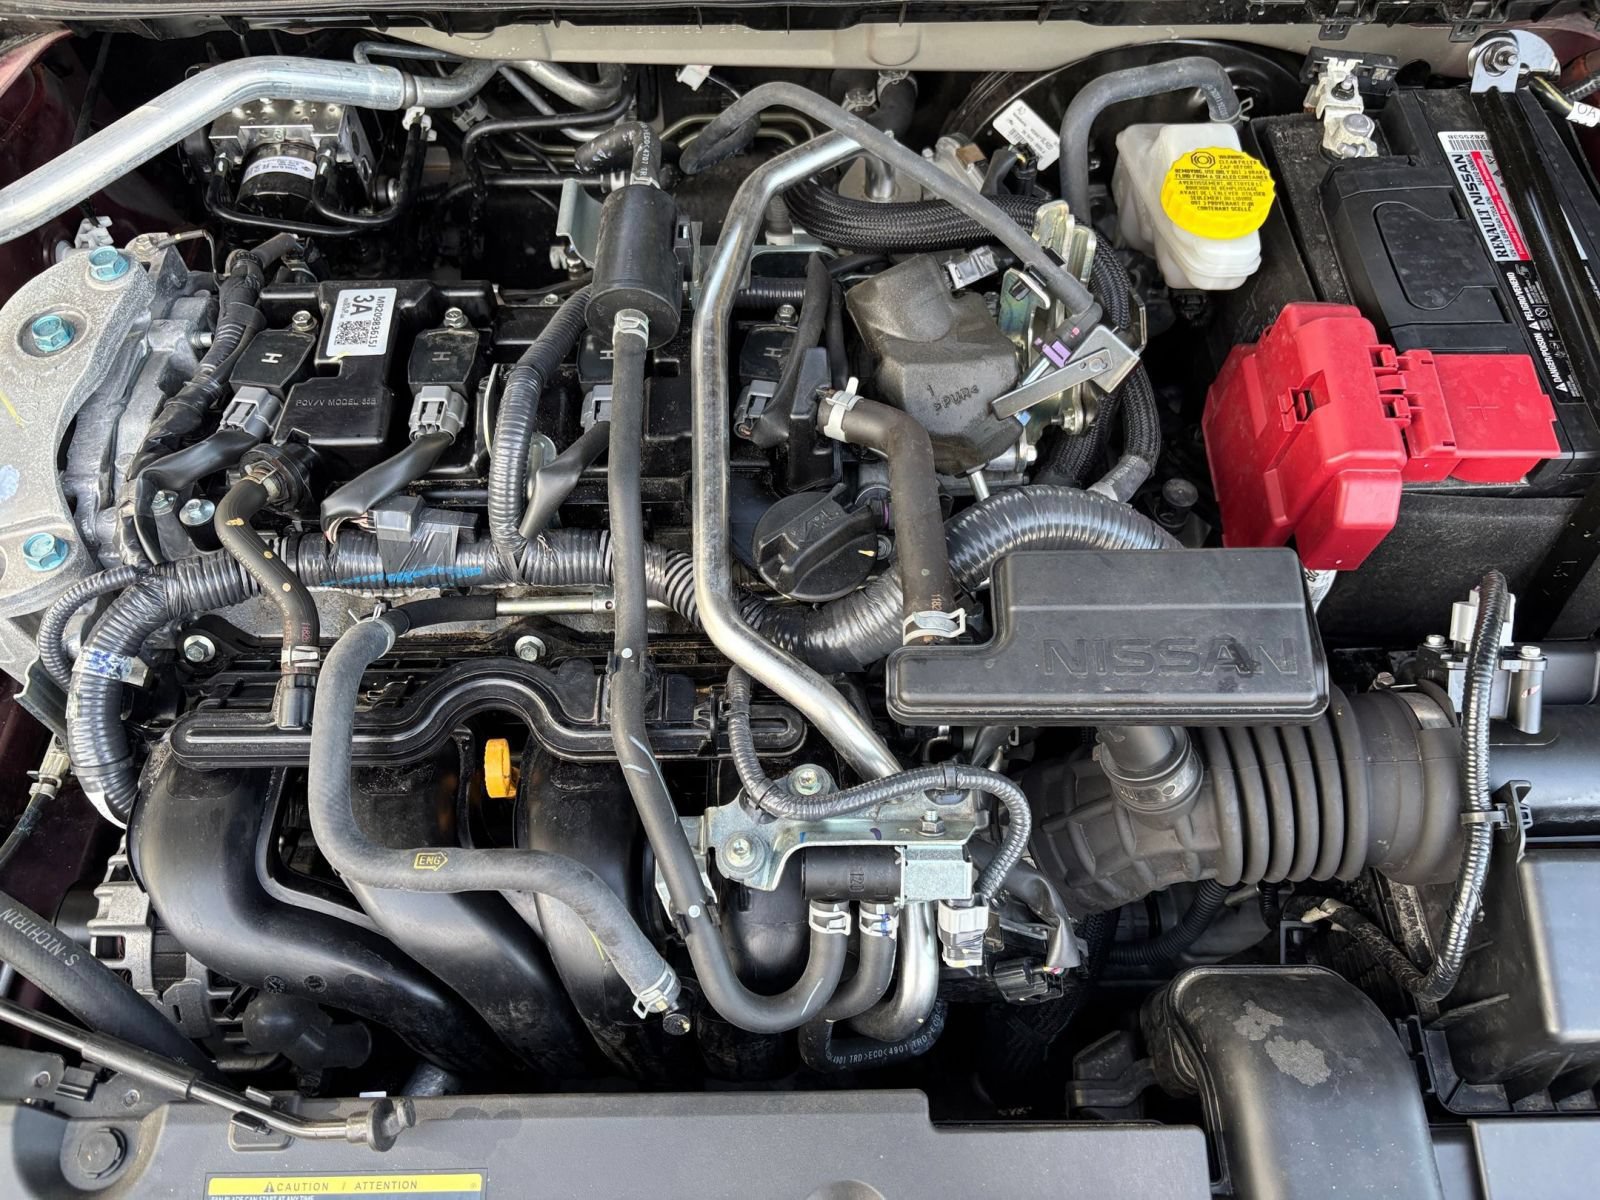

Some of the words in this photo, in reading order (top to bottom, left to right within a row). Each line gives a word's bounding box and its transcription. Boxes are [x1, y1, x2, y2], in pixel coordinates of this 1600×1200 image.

[1452, 154, 1485, 206] NISSAN
[1476, 208, 1510, 258] RENAULT
[350, 294, 375, 316] 3A
[1506, 272, 1535, 320] PELIGRO/VENENO
[1533, 332, 1562, 383] DANGER/POISON
[1043, 637, 1298, 676] NISSAN
[420, 856, 440, 865] ENG
[277, 1182, 329, 1191] CAUTION
[354, 1180, 418, 1190] ATTENTION
